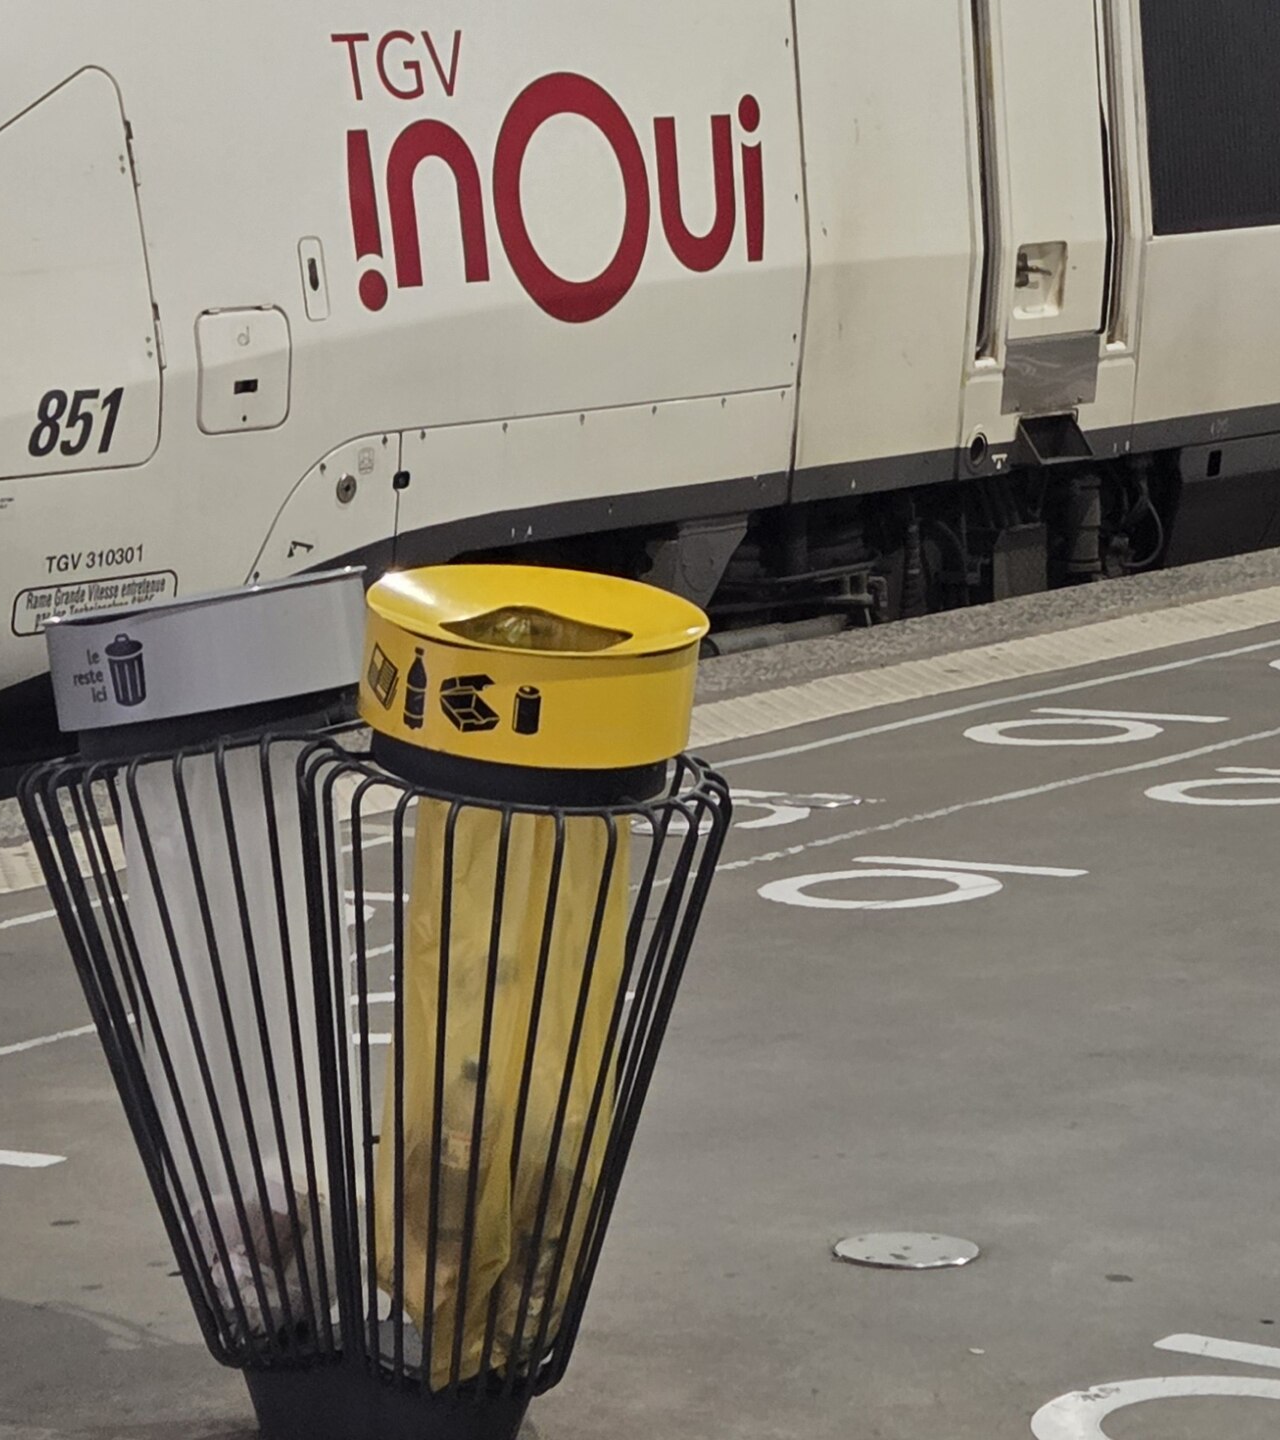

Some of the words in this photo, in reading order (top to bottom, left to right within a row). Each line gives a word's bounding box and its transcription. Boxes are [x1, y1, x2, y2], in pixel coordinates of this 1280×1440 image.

[330, 29, 462, 101] TGV
[28, 386, 125, 458] 851
[46, 552, 82, 573] TGV
[86, 544, 144, 569] 310301
[26, 591, 52, 610] Rame
[54, 586, 86, 606] Grande
[87, 648, 100, 665] le
[73, 669, 104, 686] reste
